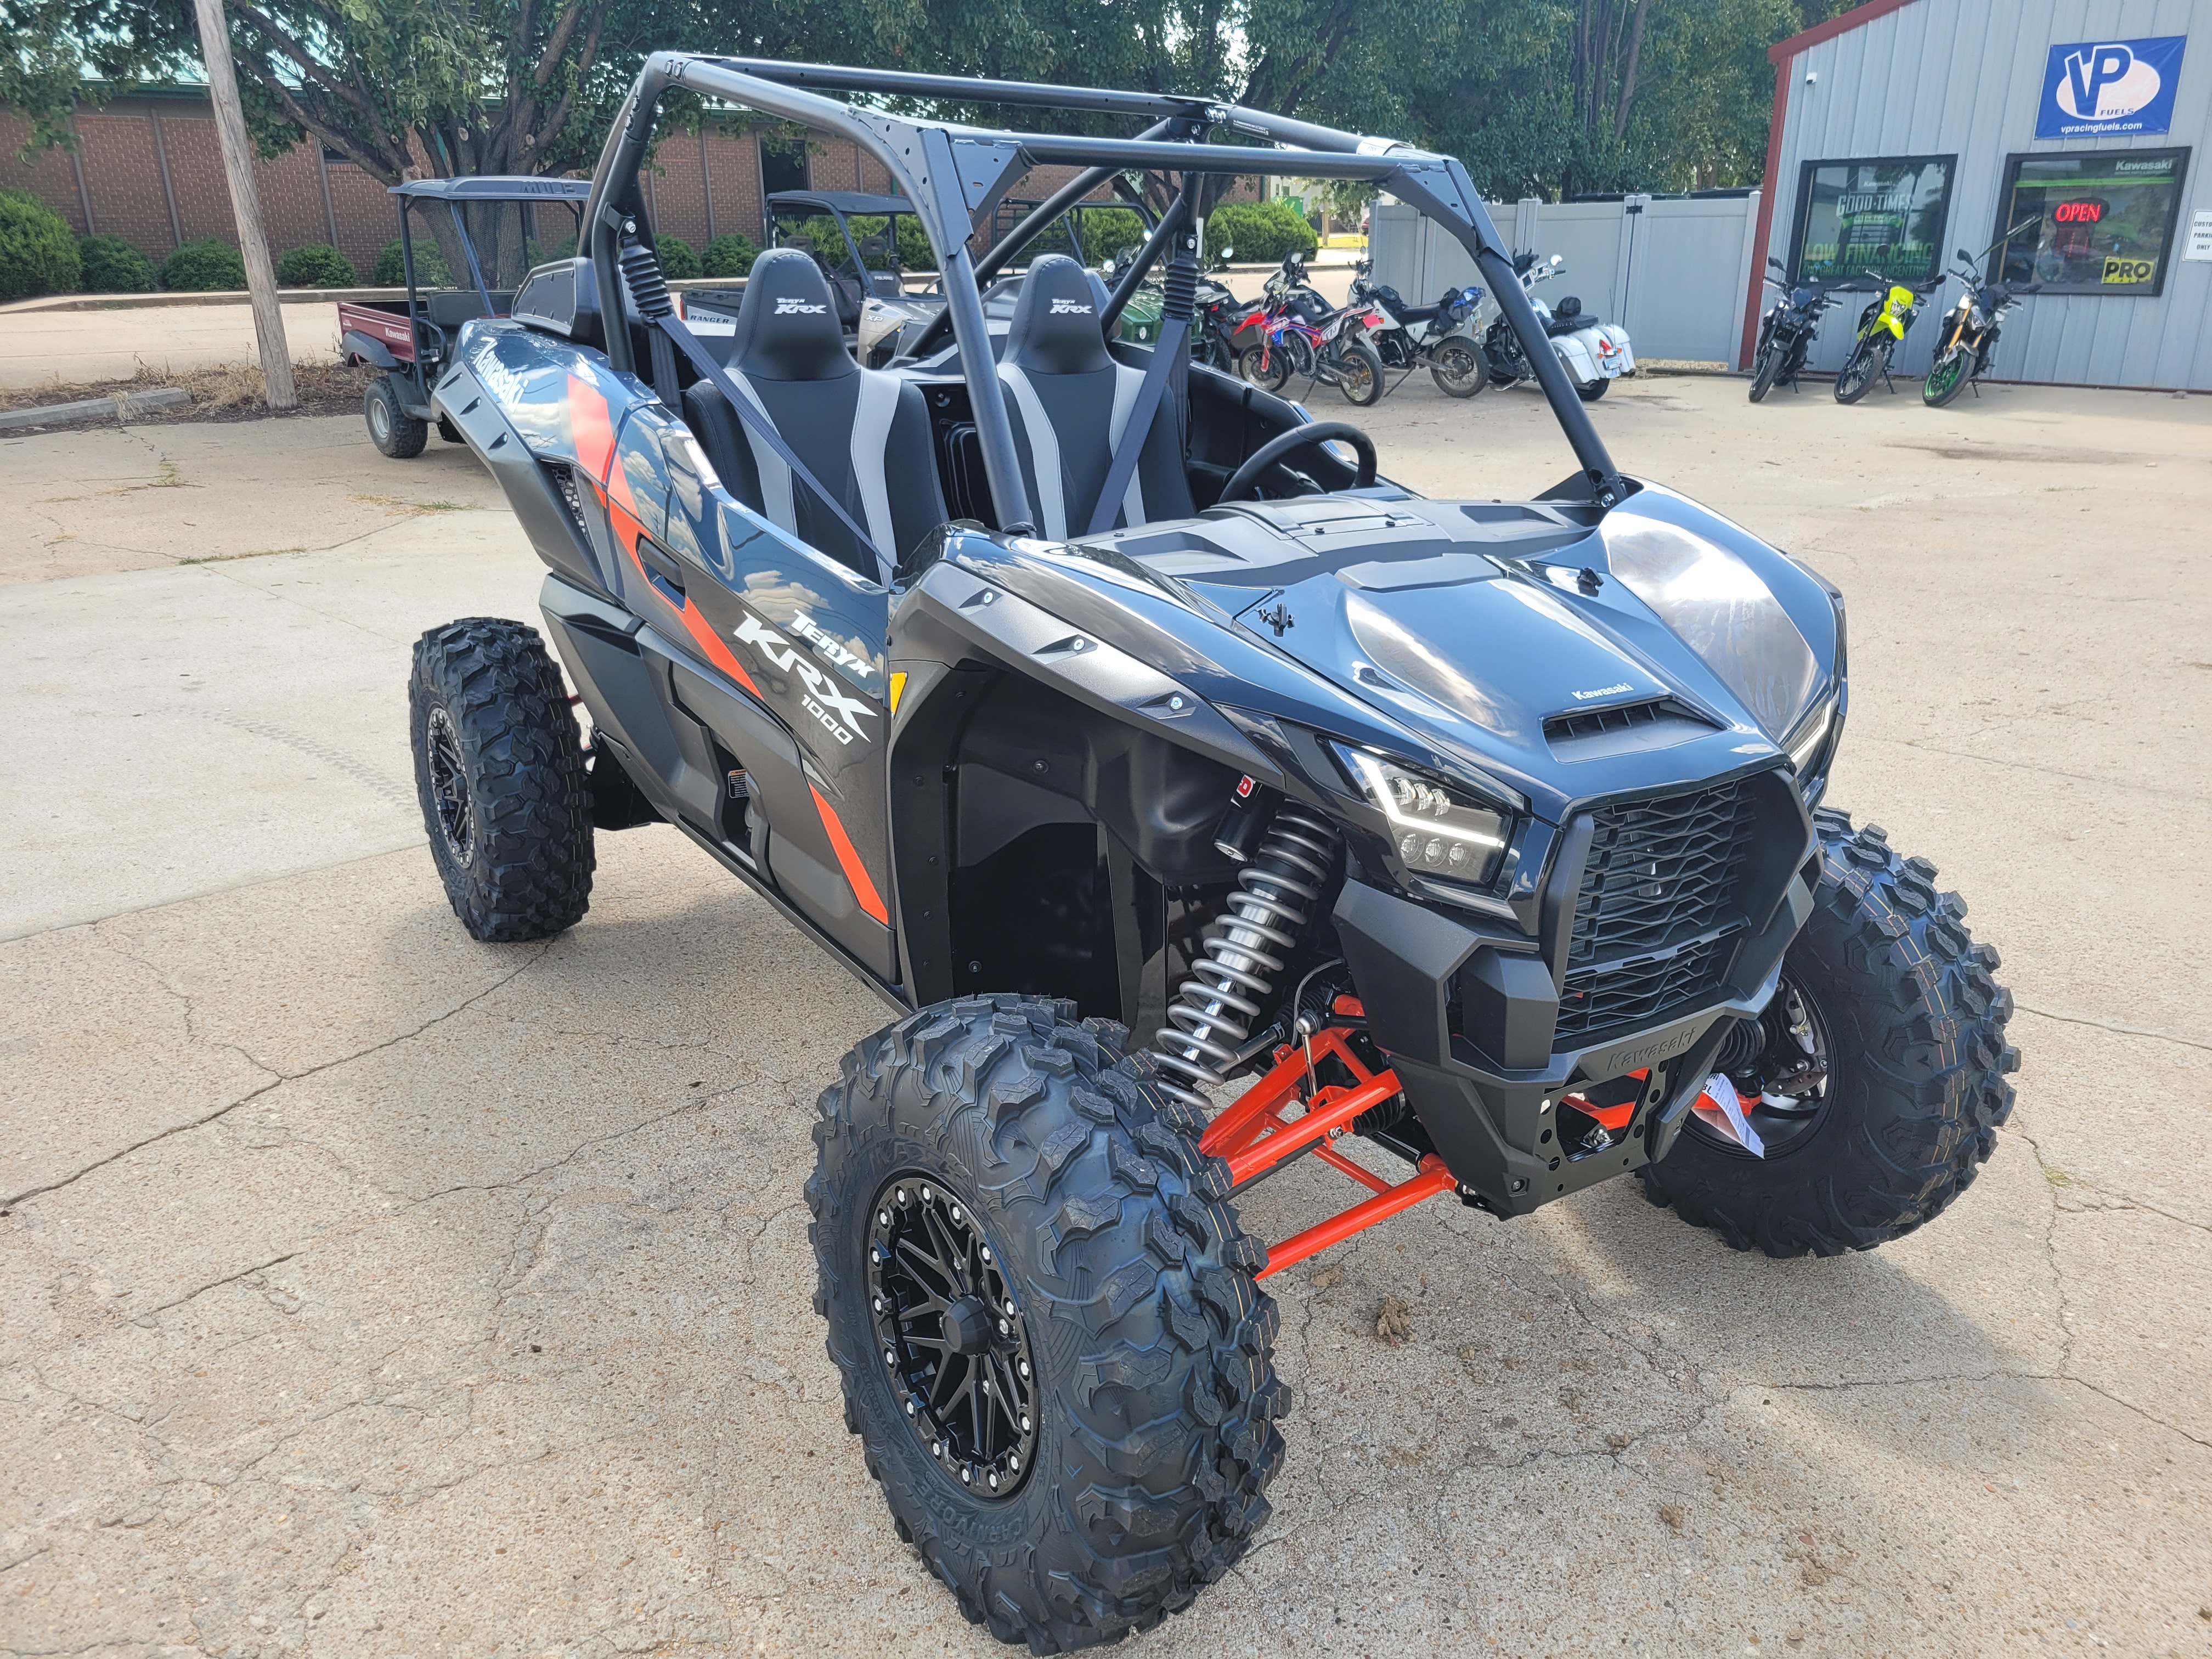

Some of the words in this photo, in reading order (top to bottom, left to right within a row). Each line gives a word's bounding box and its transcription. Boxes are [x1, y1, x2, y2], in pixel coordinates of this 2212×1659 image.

[2064, 44, 2134, 117] VP
[2100, 108, 2135, 116] FUELS
[2061, 122, 2142, 134] vpracingfuels.com
[2115, 159, 2172, 171] Kawasaki
[1836, 195, 1873, 217] GOOD
[2056, 204, 2101, 222] OPEN
[2104, 262, 2151, 278] PRO
[774, 304, 827, 314] KRX
[1049, 304, 1092, 314] KRX
[690, 315, 729, 324] RANGER
[385, 327, 410, 342] Kawasaki
[473, 337, 529, 413] Kawasaki
[733, 610, 878, 743] KRX
[1571, 682, 1634, 700] Kawasaki
[801, 693, 854, 745] 1000
[1607, 1026, 1696, 1071] Kawasaki
